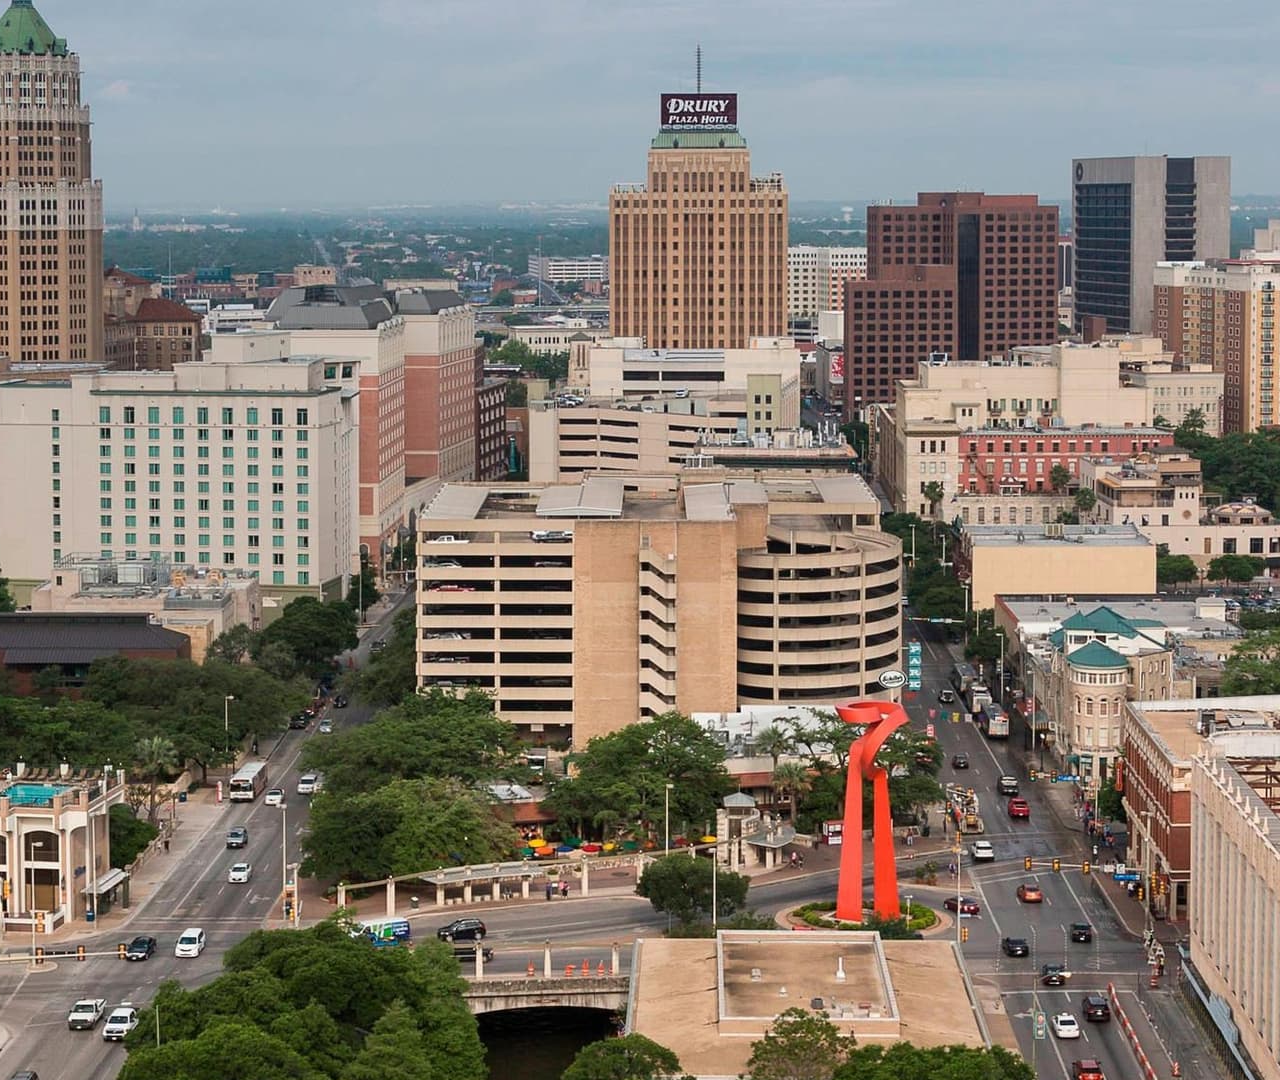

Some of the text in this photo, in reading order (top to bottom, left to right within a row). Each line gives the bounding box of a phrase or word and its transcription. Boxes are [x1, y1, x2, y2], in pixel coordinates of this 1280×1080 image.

[667, 98, 729, 114] DRURY
[668, 115, 729, 124] PLAZA HOTEL
[908, 643, 921, 688] PARK
